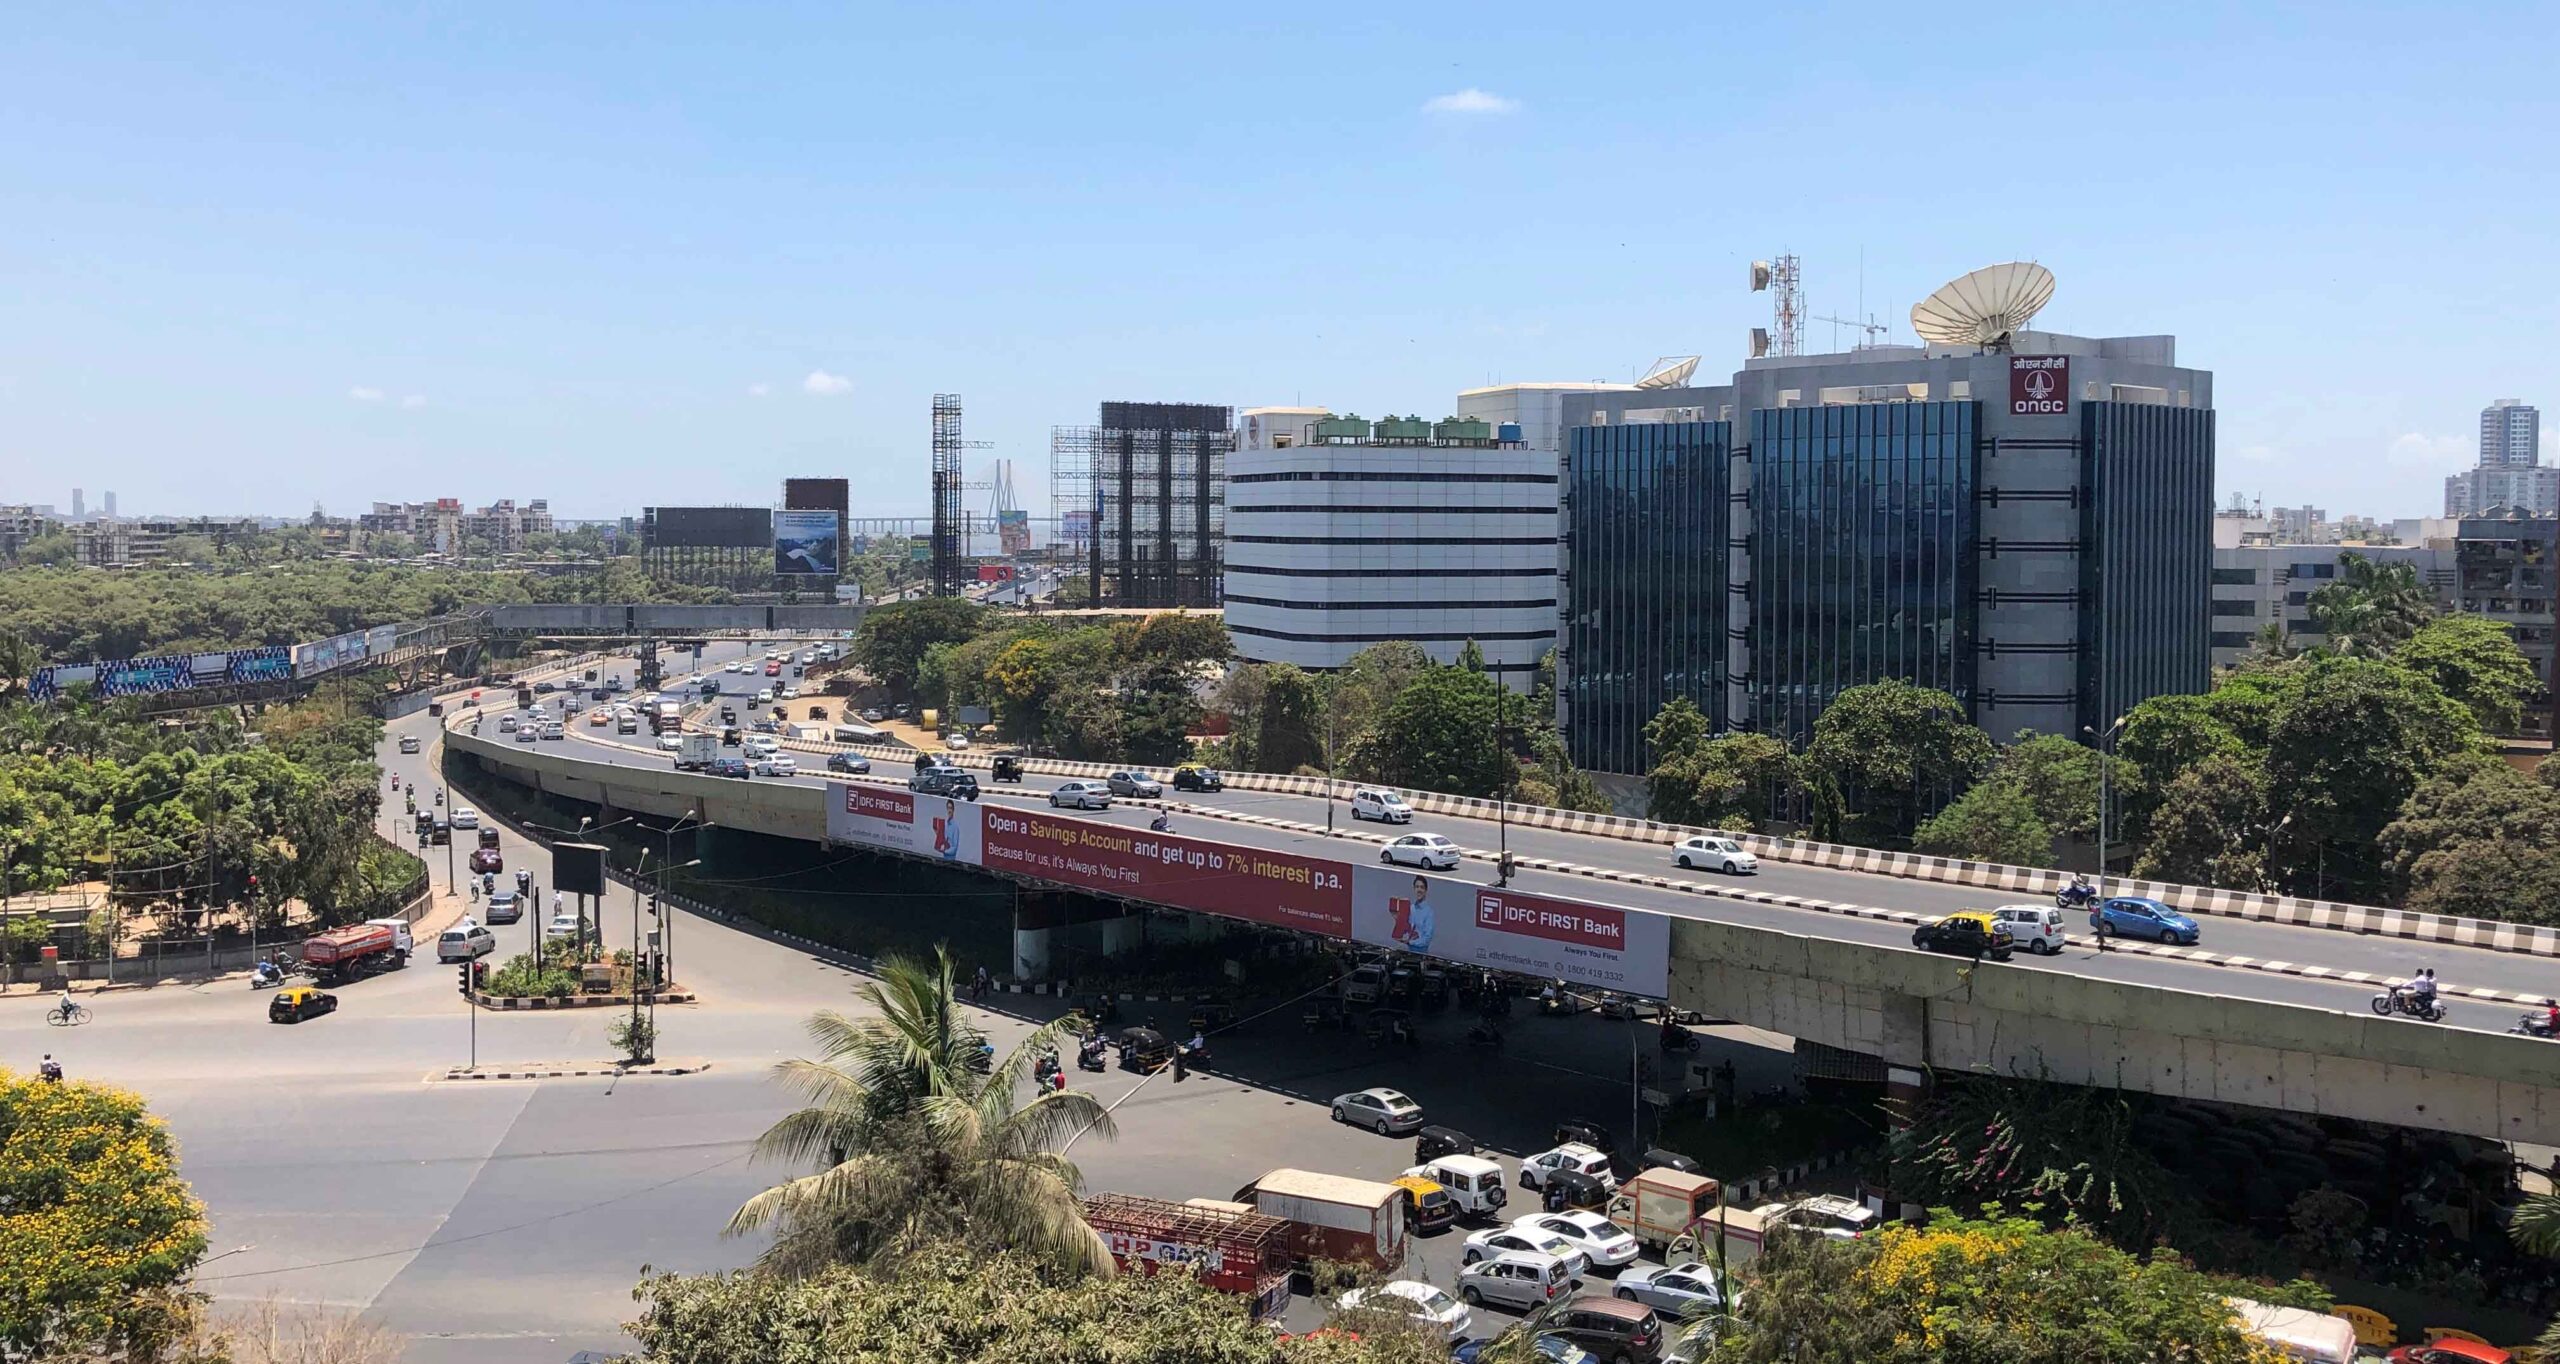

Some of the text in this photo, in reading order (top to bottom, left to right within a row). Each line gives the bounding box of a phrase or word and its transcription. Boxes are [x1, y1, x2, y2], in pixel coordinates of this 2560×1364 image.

[2013, 358, 2065, 369] ओएनजीसी
[859, 796, 912, 814] IDFC FIRST Bank
[988, 813, 1343, 889] Open a Savings Account and get up to 7% interest p.a.
[988, 842, 1140, 883] Because for us, it's Always You First
[1504, 906, 1620, 938] IDFC FIRST Bank
[1489, 951, 1624, 982] idfcfirstbank.com 1800 419 3332
[1564, 946, 1588, 957] Always
[1589, 950, 1601, 959] You
